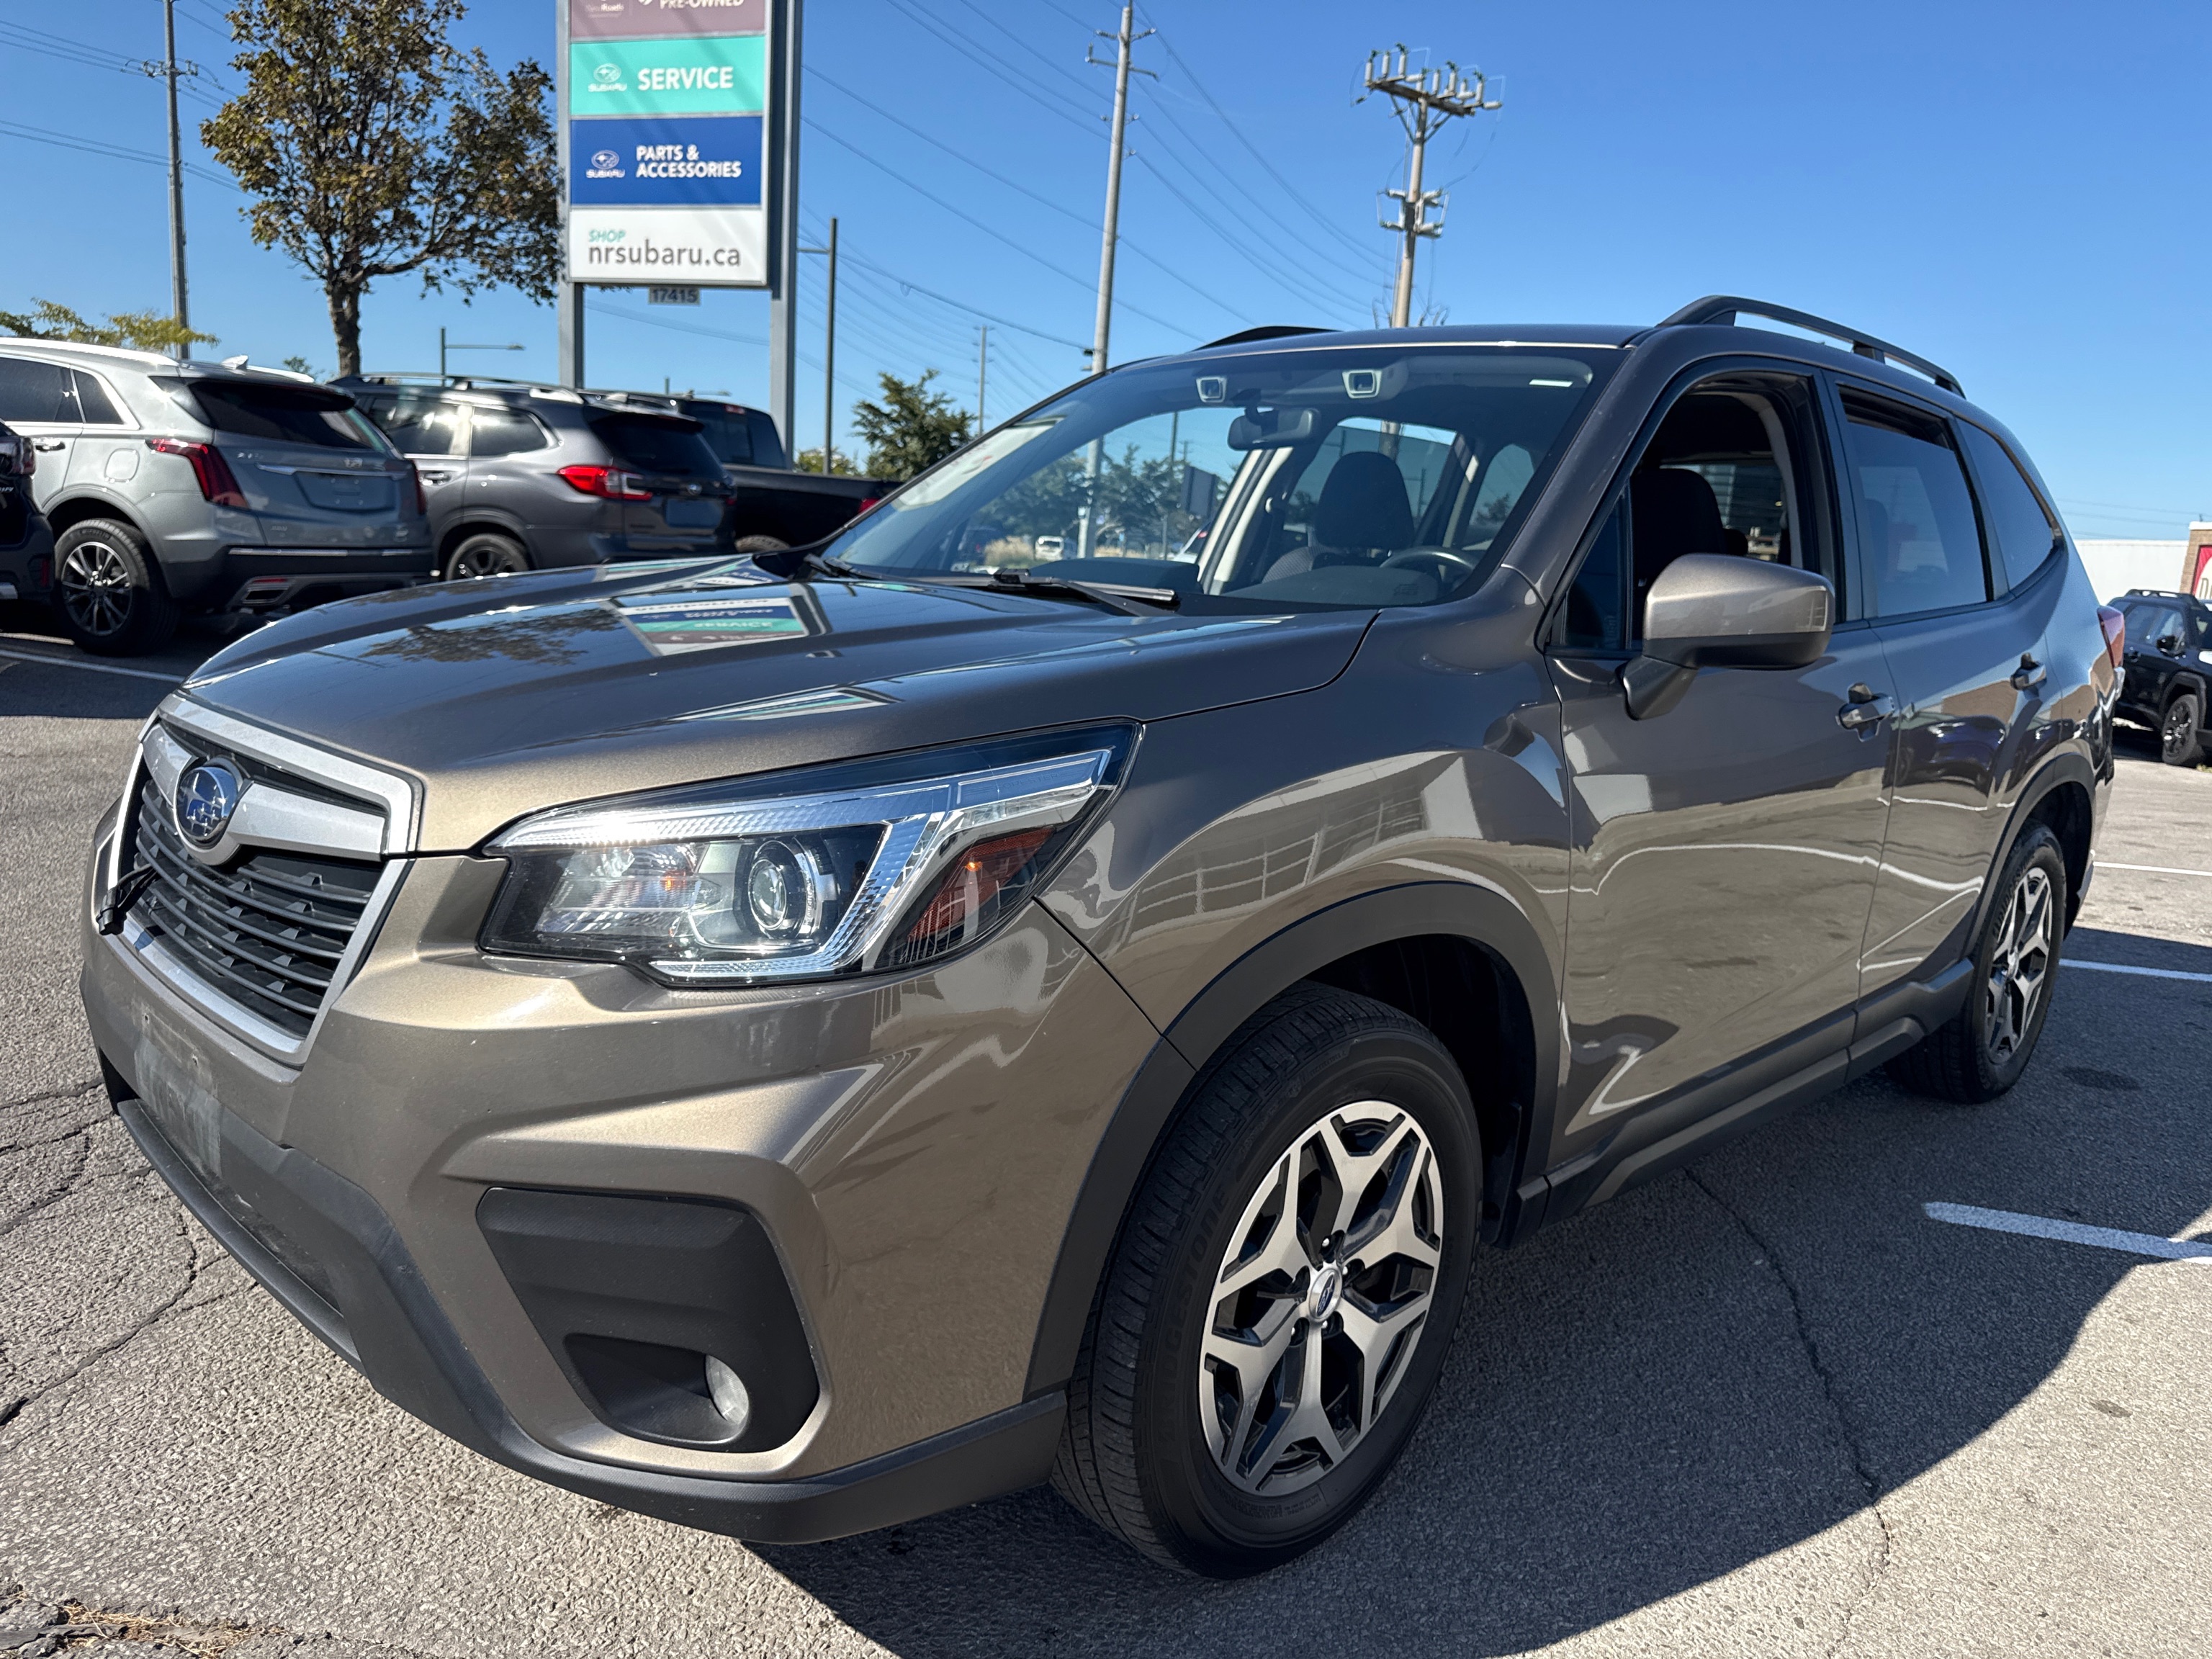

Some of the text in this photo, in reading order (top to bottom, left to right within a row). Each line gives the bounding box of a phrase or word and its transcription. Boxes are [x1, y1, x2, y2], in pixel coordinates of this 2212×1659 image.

[637, 66, 734, 91] SERVICE
[636, 144, 699, 161] PARTS &
[636, 161, 742, 178] ACCESSORIES
[588, 230, 626, 243] SHOP
[588, 238, 741, 266] nrsubaru.ca
[652, 289, 696, 303] 17415
